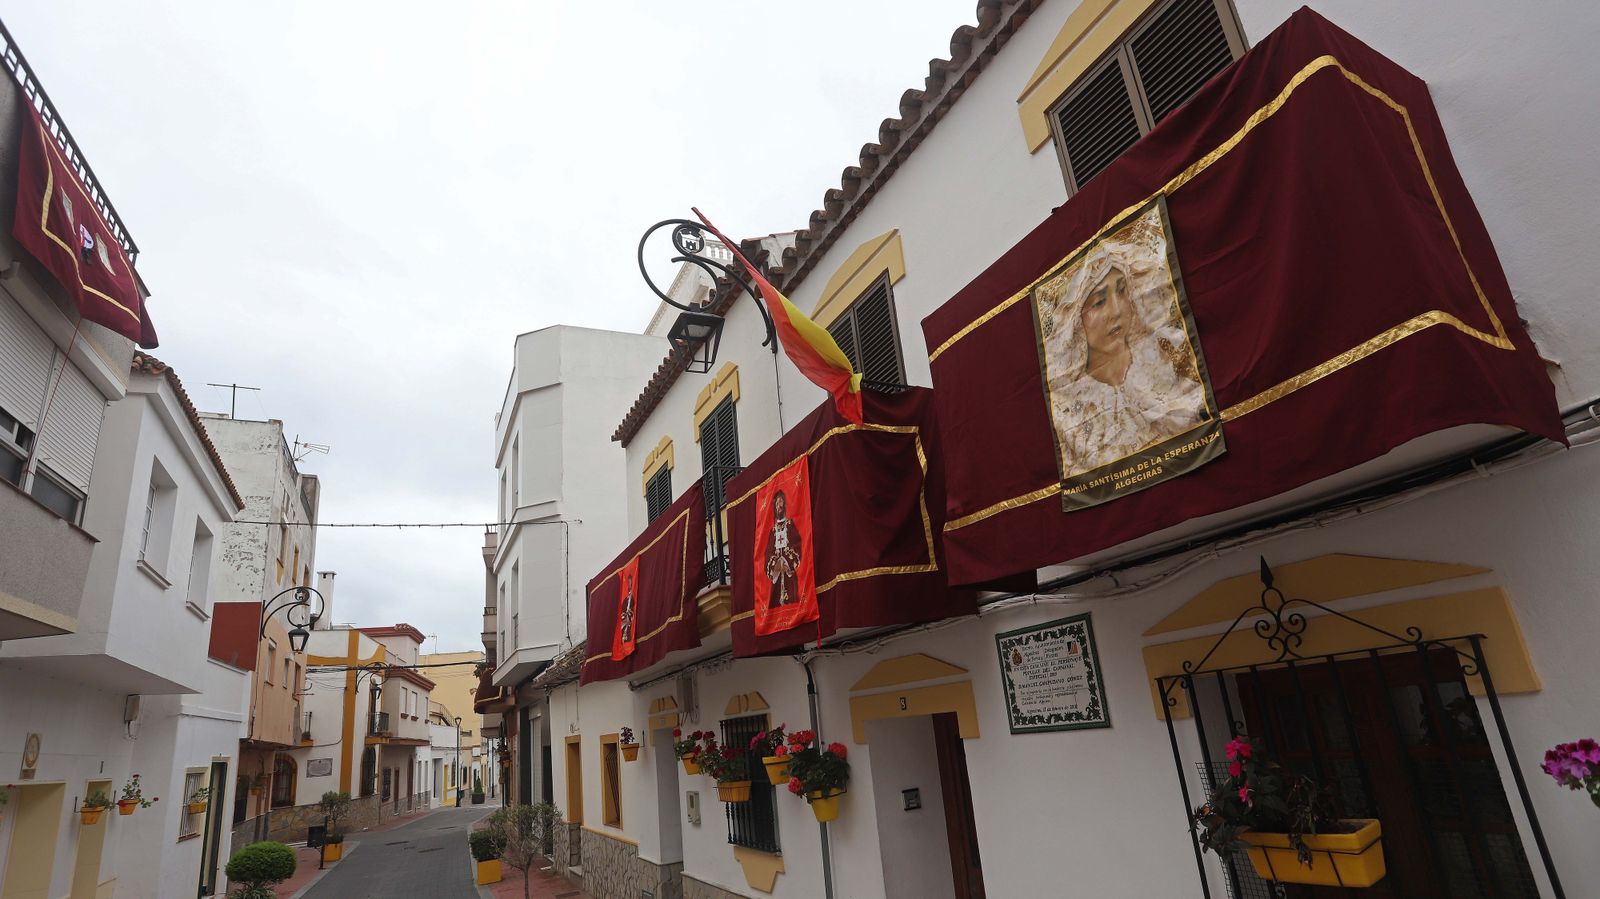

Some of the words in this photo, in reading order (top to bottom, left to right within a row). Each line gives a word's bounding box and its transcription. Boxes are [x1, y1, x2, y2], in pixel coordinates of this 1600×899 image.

[1063, 482, 1087, 496] MARÍA
[1089, 467, 1136, 489] SANTÍSIMA
[1138, 461, 1149, 472] DE
[1151, 456, 1162, 467] LA
[1164, 431, 1220, 461] ESPERANZA
[1115, 467, 1162, 490] ALGECIRAS
